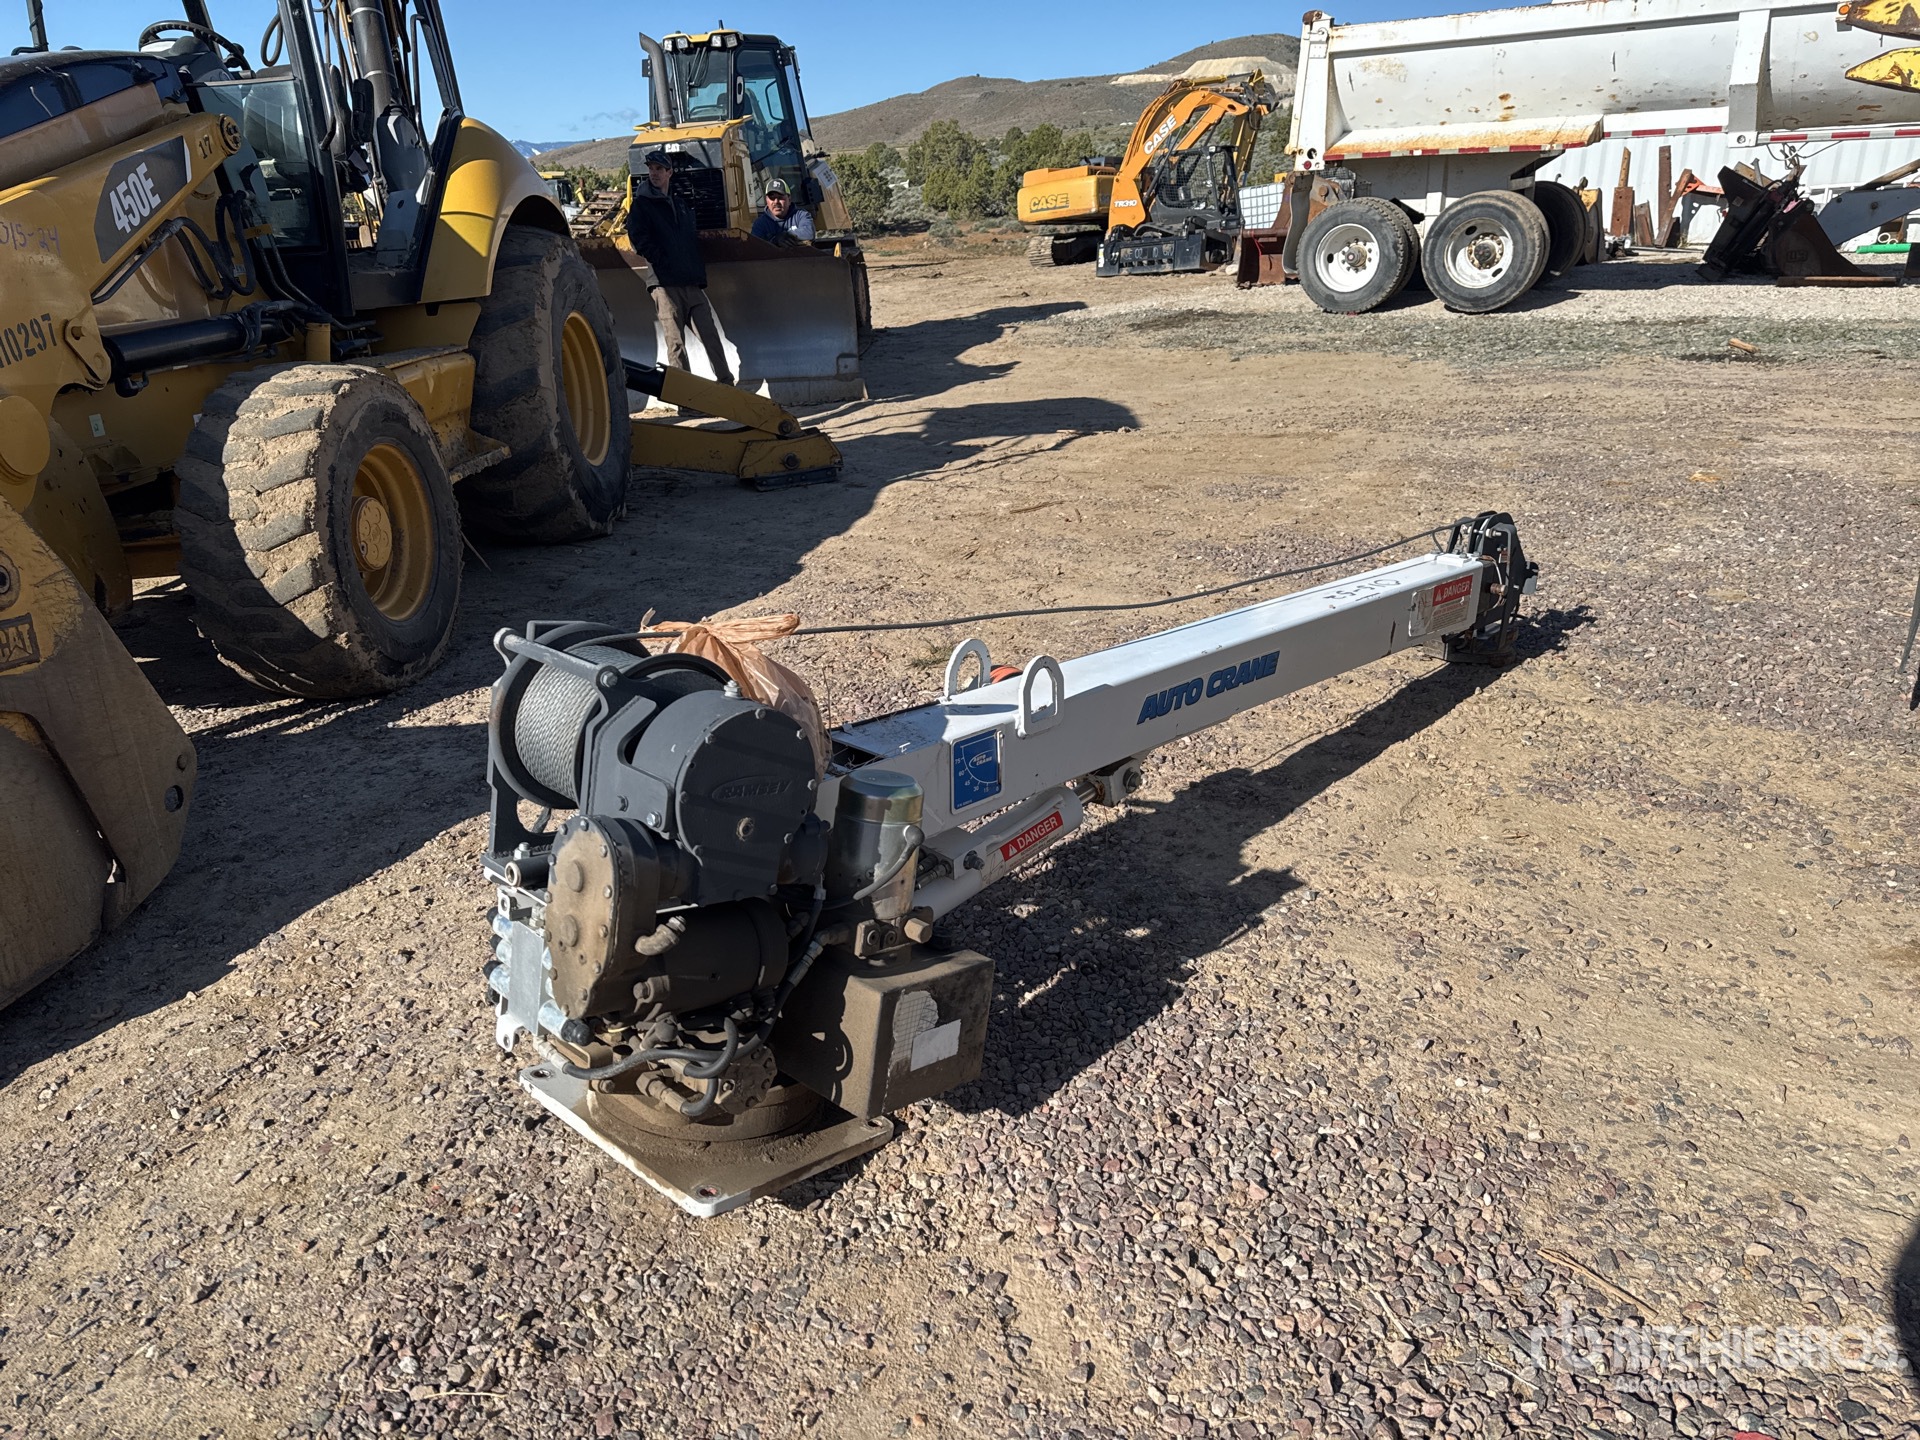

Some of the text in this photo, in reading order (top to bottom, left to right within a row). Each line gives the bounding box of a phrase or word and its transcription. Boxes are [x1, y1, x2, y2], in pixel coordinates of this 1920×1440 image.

[665, 143, 680, 153] CAT
[1143, 115, 1177, 155] CASE
[109, 162, 161, 234] 450E
[1029, 193, 1070, 213] CASE
[1113, 199, 1138, 208] TR310
[0, 312, 58, 368] 10297
[1443, 580, 1470, 599] DANGER
[1136, 650, 1281, 725] AUTO CRANE
[1016, 816, 1058, 849] DANGER
